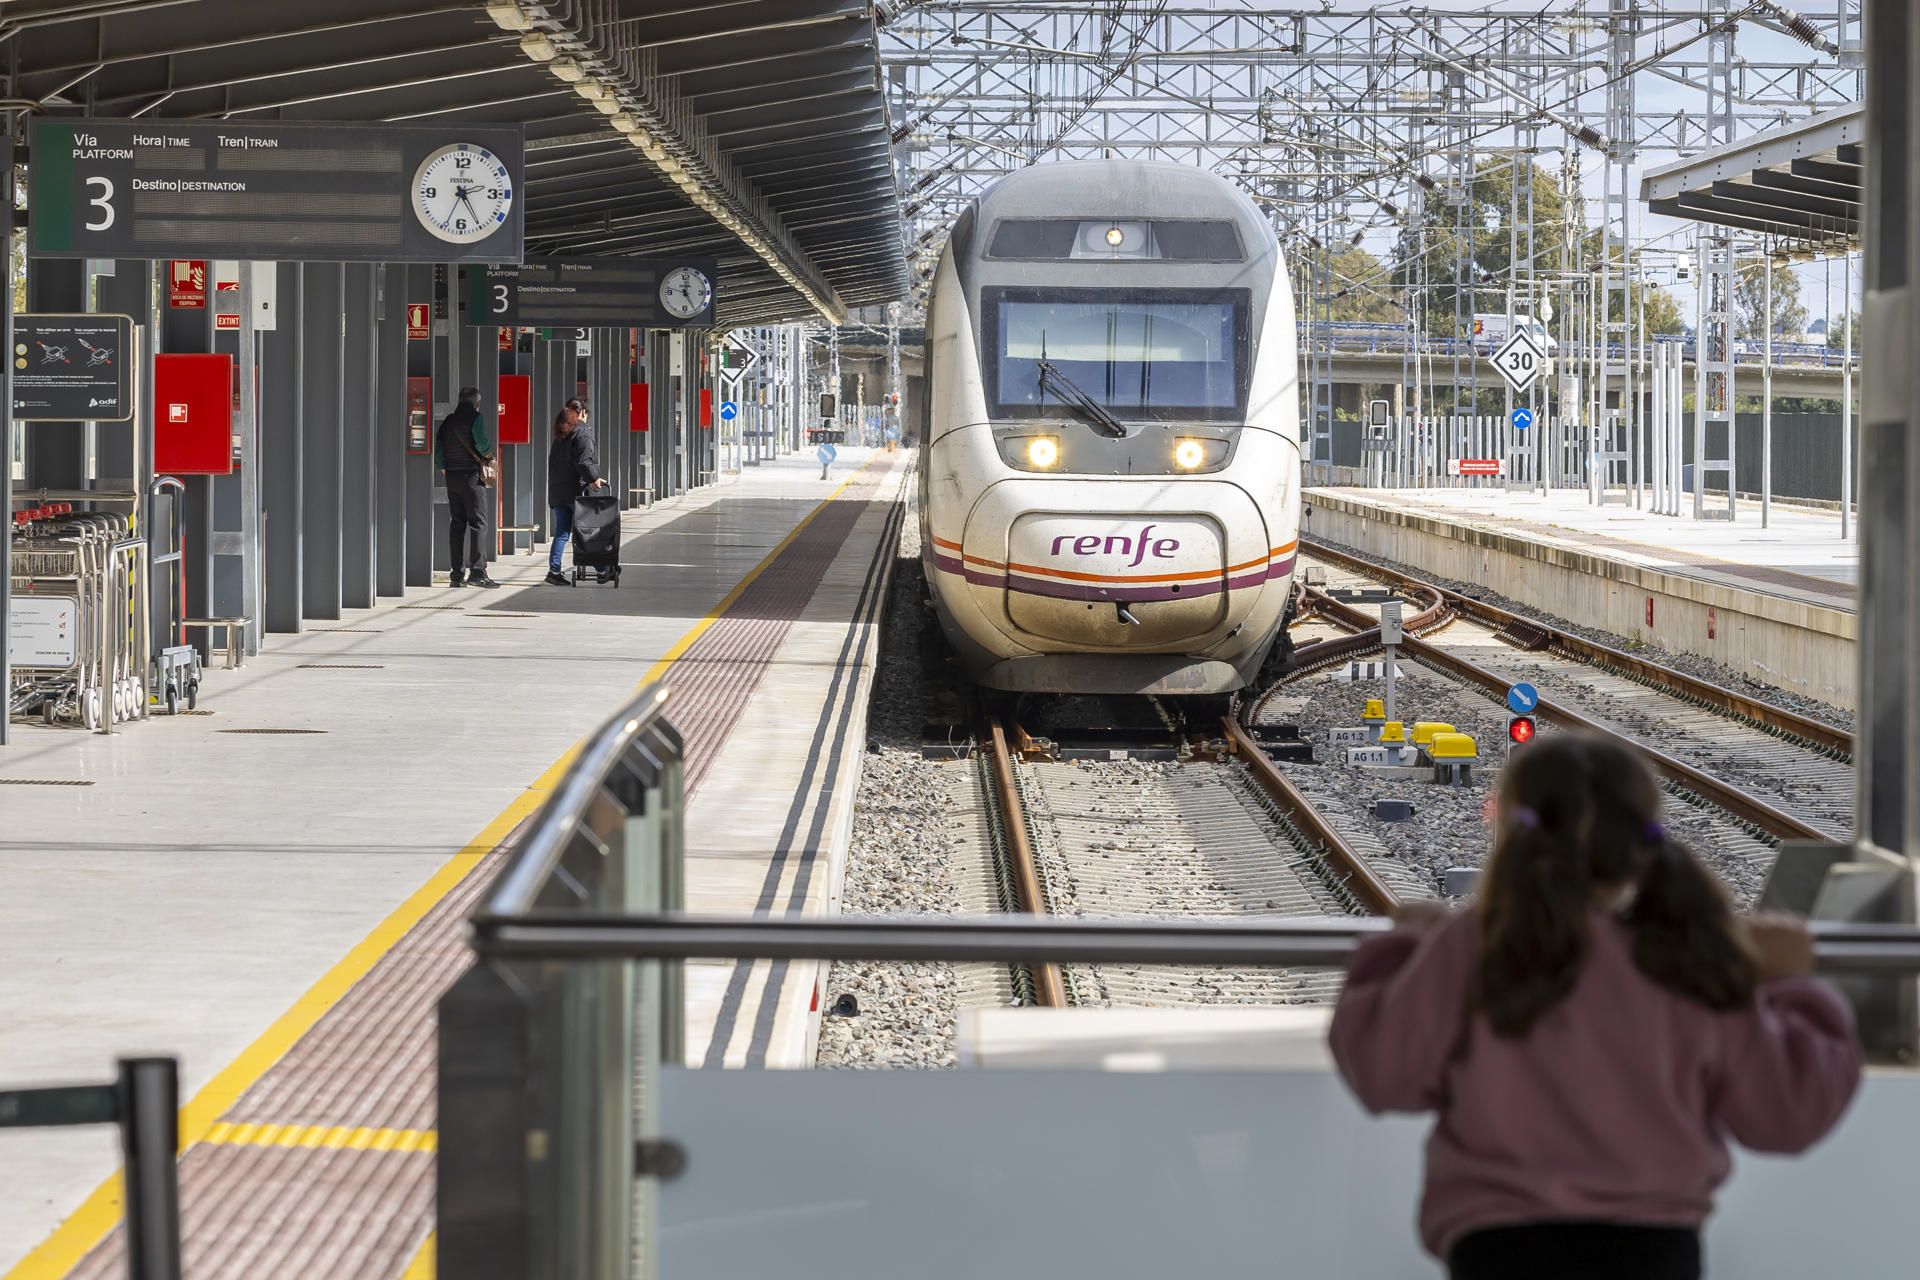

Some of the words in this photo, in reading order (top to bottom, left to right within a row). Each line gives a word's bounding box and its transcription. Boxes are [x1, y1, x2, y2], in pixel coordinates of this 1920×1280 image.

[73, 149, 134, 159] PLATFORM
[454, 157, 472, 169] 12
[425, 187, 437, 199] 9
[487, 188, 498, 200] 3
[85, 176, 116, 232] 3
[455, 218, 467, 230] 6
[492, 284, 509, 313] 3
[740, 358, 747, 368] 3
[1508, 351, 1533, 371] 30
[1050, 524, 1180, 568] renfe
[1335, 732, 1349, 741] AG
[1351, 732, 1364, 741] 1.2
[1353, 752, 1368, 762] AG
[1370, 752, 1384, 762] 1.1
